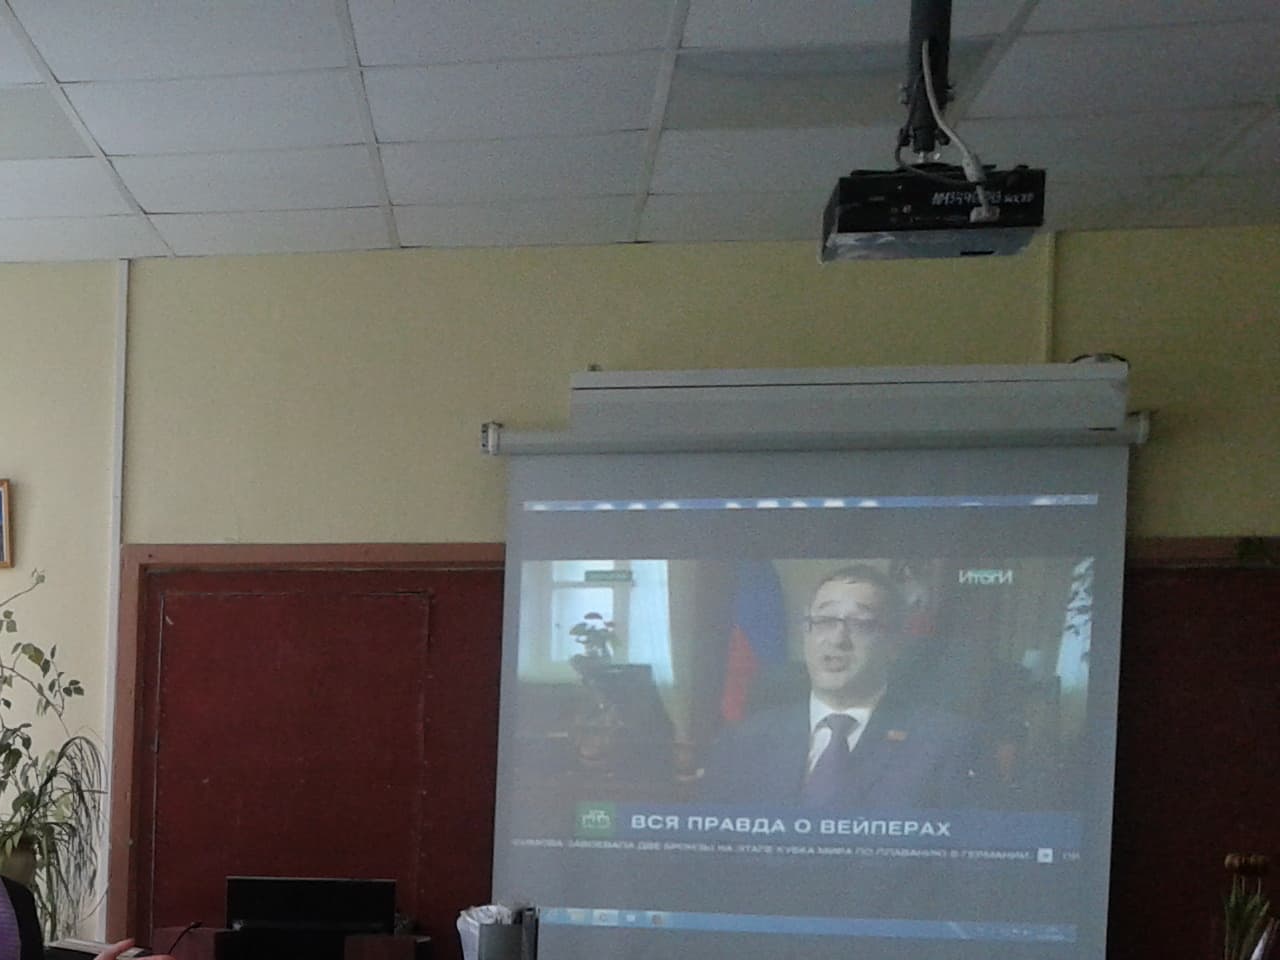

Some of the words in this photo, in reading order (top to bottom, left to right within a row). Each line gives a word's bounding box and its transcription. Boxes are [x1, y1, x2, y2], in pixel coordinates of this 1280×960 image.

[631, 814, 680, 831] ВСЯ
[687, 815, 786, 834] ПРАВДА
[793, 818, 812, 834] О
[819, 816, 952, 837] ВЕЙПЕРАХ
